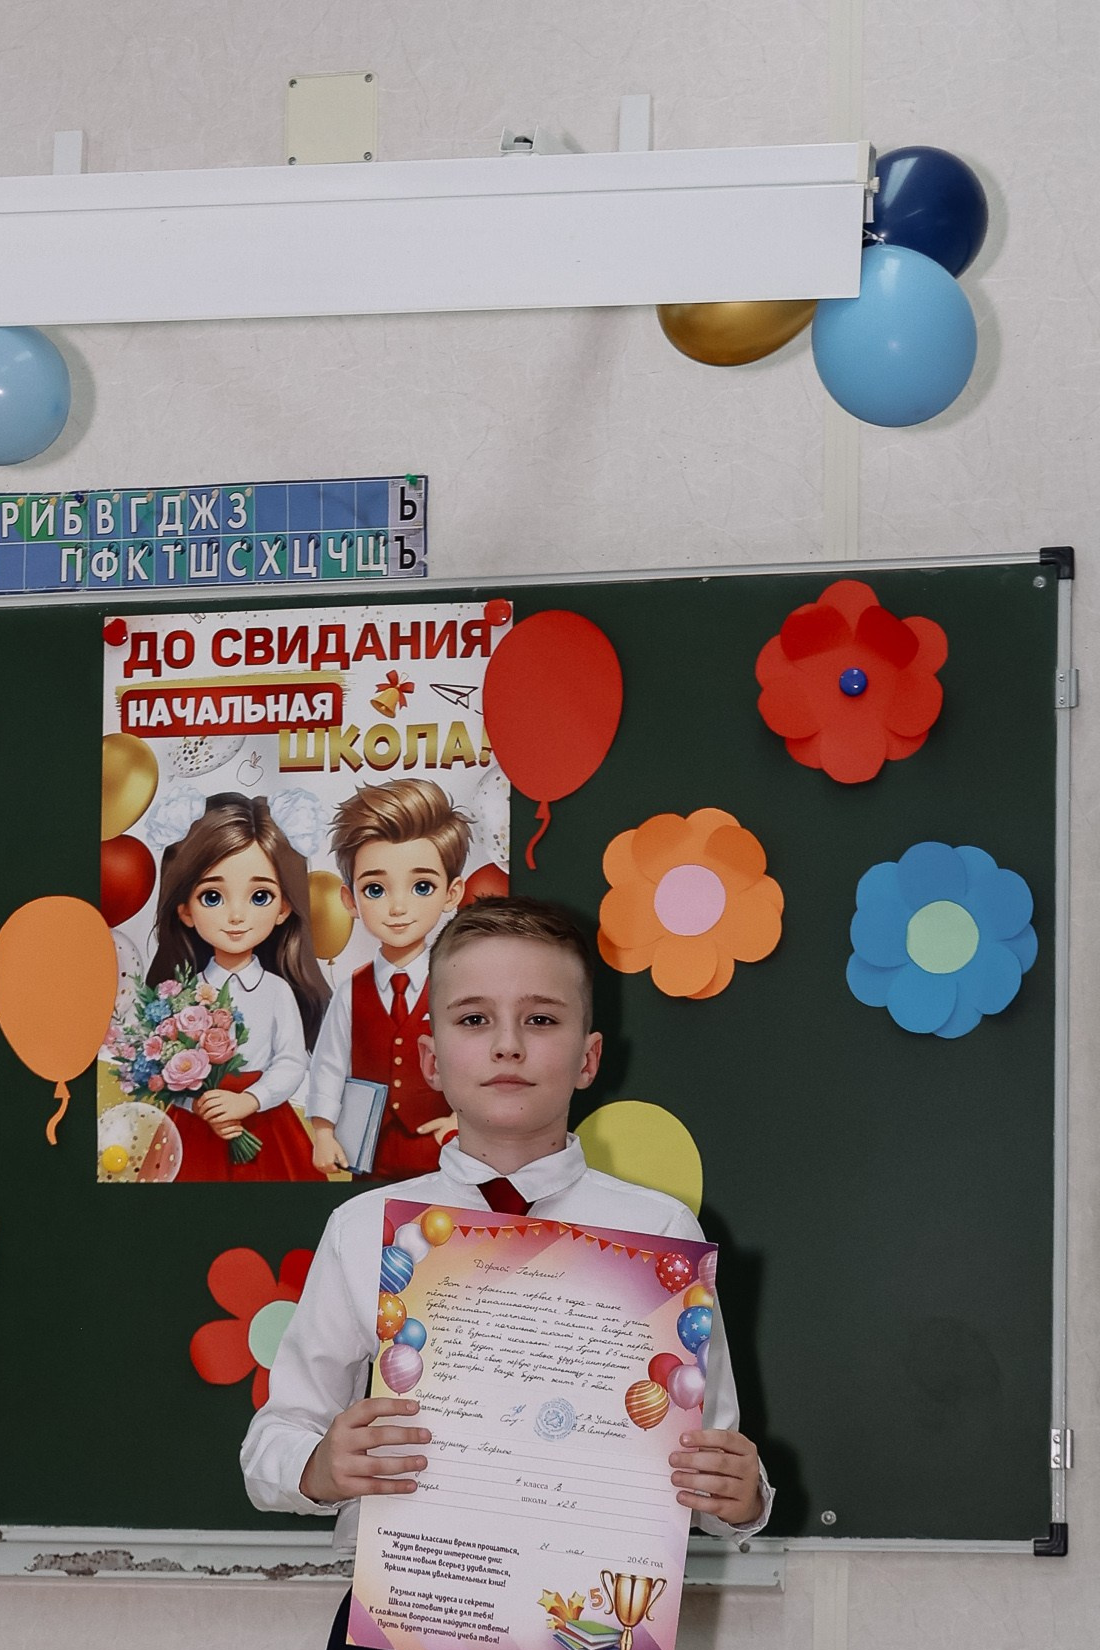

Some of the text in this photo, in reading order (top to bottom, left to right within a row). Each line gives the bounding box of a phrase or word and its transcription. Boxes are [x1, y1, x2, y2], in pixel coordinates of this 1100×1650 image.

[122, 618, 491, 678] ДО СВИДАНИЯ
[127, 692, 333, 728] НАЧАЛЬНАЯ
[474, 1259, 510, 1273] Дорогой
[438, 1276, 460, 1287] Вот
[477, 1285, 518, 1295] прошли
[564, 1309, 599, 1320] Вместе
[495, 1323, 538, 1334] начальной
[601, 1325, 633, 1337] Сегодня
[445, 1351, 479, 1360] забывай
[484, 1355, 502, 1363] свою
[576, 1345, 601, 1354] Пусть
[453, 1363, 484, 1372] который
[494, 1365, 515, 1378] всегда
[521, 1371, 545, 1382] будет
[524, 1481, 548, 1490] класса
[521, 1496, 547, 1505] школы
[383, 1529, 420, 1540] младшими
[421, 1534, 452, 1545] классами
[454, 1538, 476, 1548] время
[478, 1543, 519, 1555] прощаться,
[392, 1541, 413, 1551] Ждут
[415, 1544, 442, 1555] впереди
[444, 1550, 486, 1561] интересные
[381, 1550, 510, 1577] Знаниям новым всерьез удивляться,
[384, 1562, 506, 1587] Ярким мирам увлекательных книг!
[390, 1586, 416, 1597] Разных
[417, 1591, 433, 1600] наук
[434, 1594, 457, 1604] чудеса
[464, 1599, 494, 1608] секреты
[590, 1587, 605, 1610] 5
[389, 1598, 494, 1620] Школа готовит уже для тебя!
[369, 1606, 509, 1634] К сложным вопросам найдутся ответы!
[378, 1619, 499, 1644] Пусть будет успешной учеба твоя!
